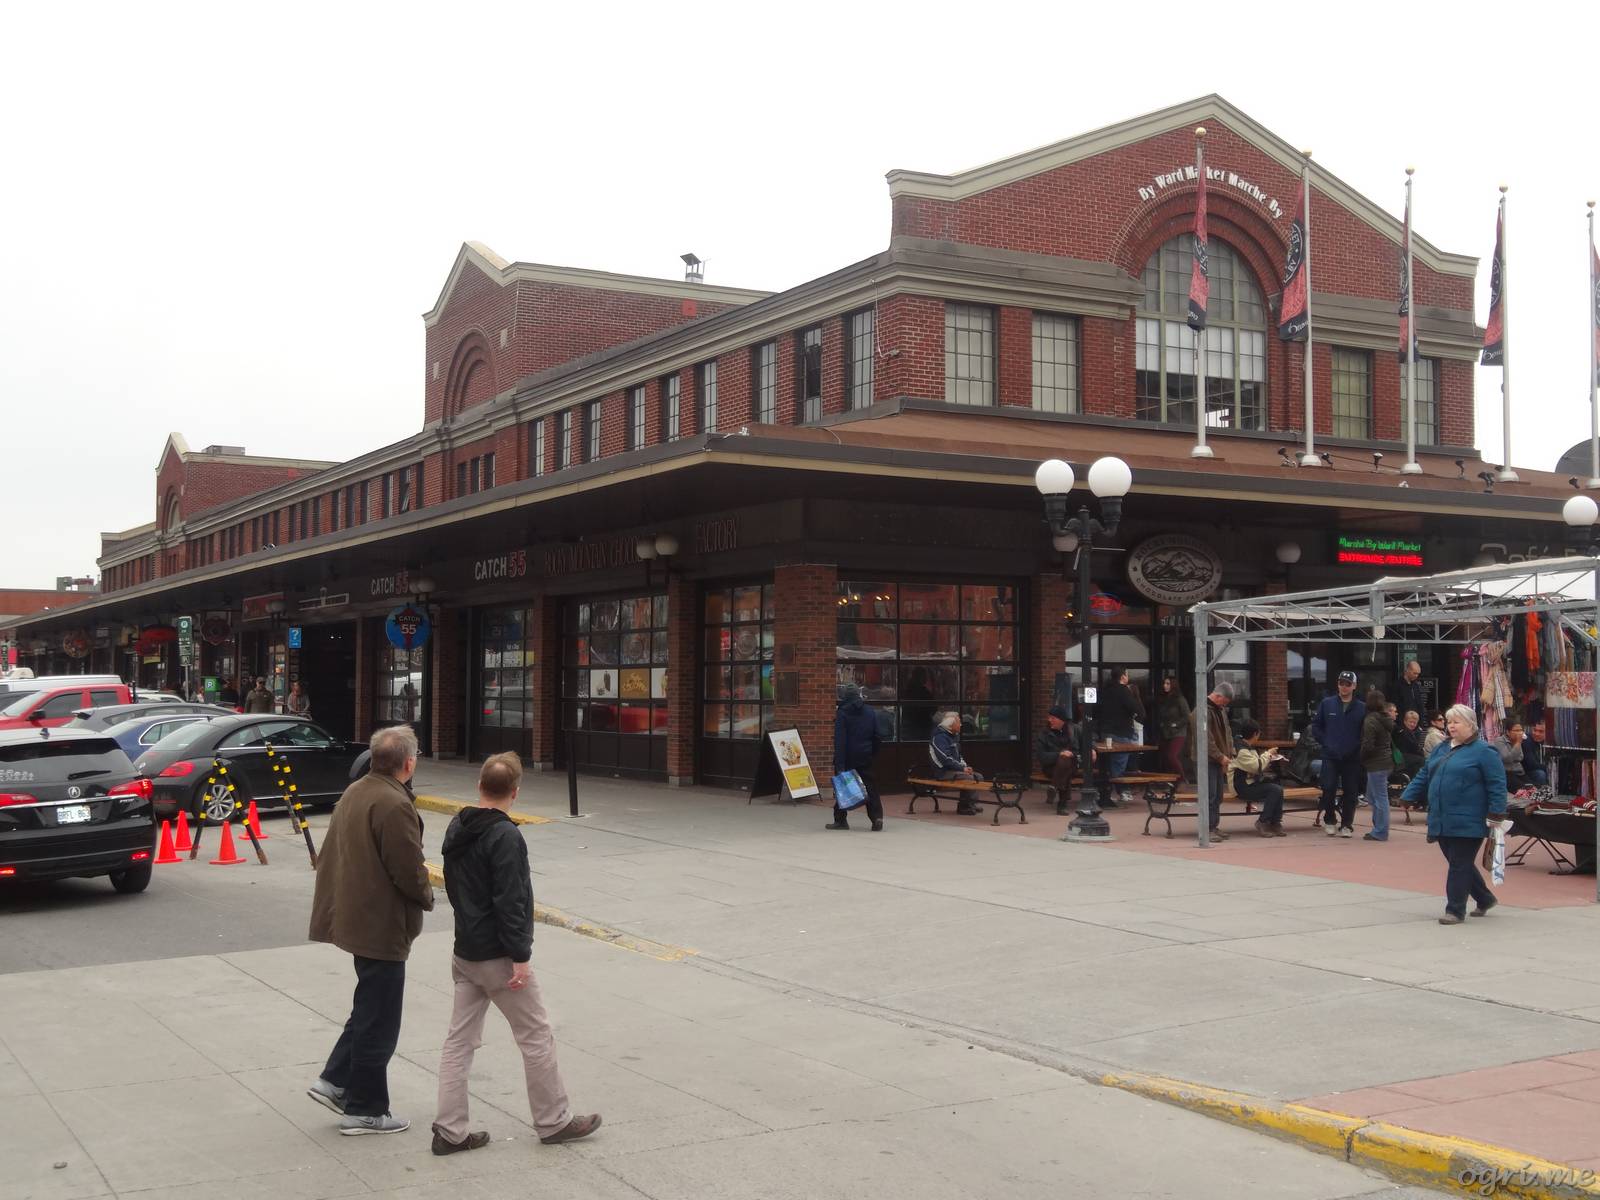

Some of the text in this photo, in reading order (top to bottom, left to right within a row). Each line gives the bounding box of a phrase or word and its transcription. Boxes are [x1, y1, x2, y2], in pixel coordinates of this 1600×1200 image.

[1138, 186, 1156, 201] By
[1155, 169, 1184, 189] Ward
[1184, 165, 1225, 182] Maket
[1269, 199, 1283, 219] By
[474, 550, 527, 581] CATCH 55
[370, 570, 409, 596] CATCH 55
[398, 614, 421, 623] CATCH
[400, 624, 417, 635] 55
